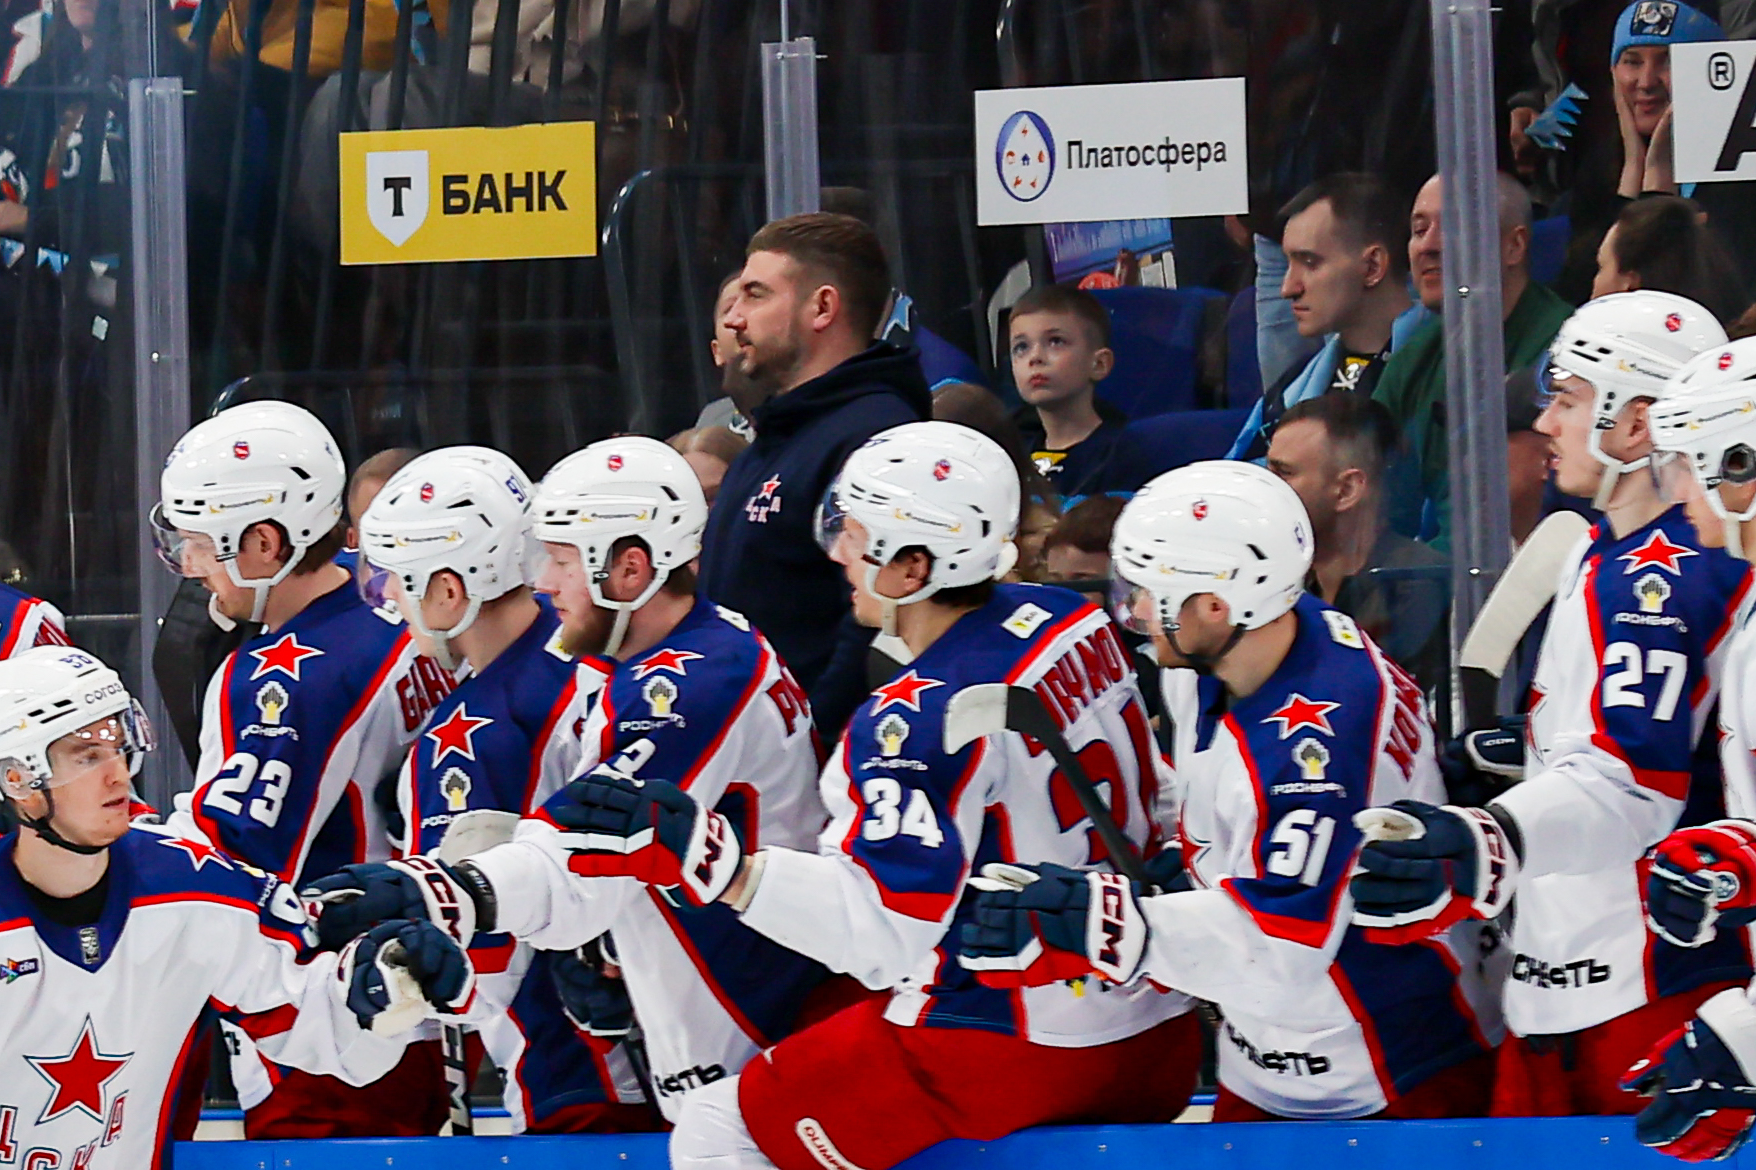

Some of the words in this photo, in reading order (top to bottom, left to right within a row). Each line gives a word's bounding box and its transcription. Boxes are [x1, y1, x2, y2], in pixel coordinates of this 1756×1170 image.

[1067, 136, 1228, 173] Платосфера
[442, 170, 569, 216] БАНК
[1602, 640, 1688, 722] 27
[203, 751, 292, 828] 23
[862, 777, 944, 848] 34
[1267, 808, 1338, 887] 51
